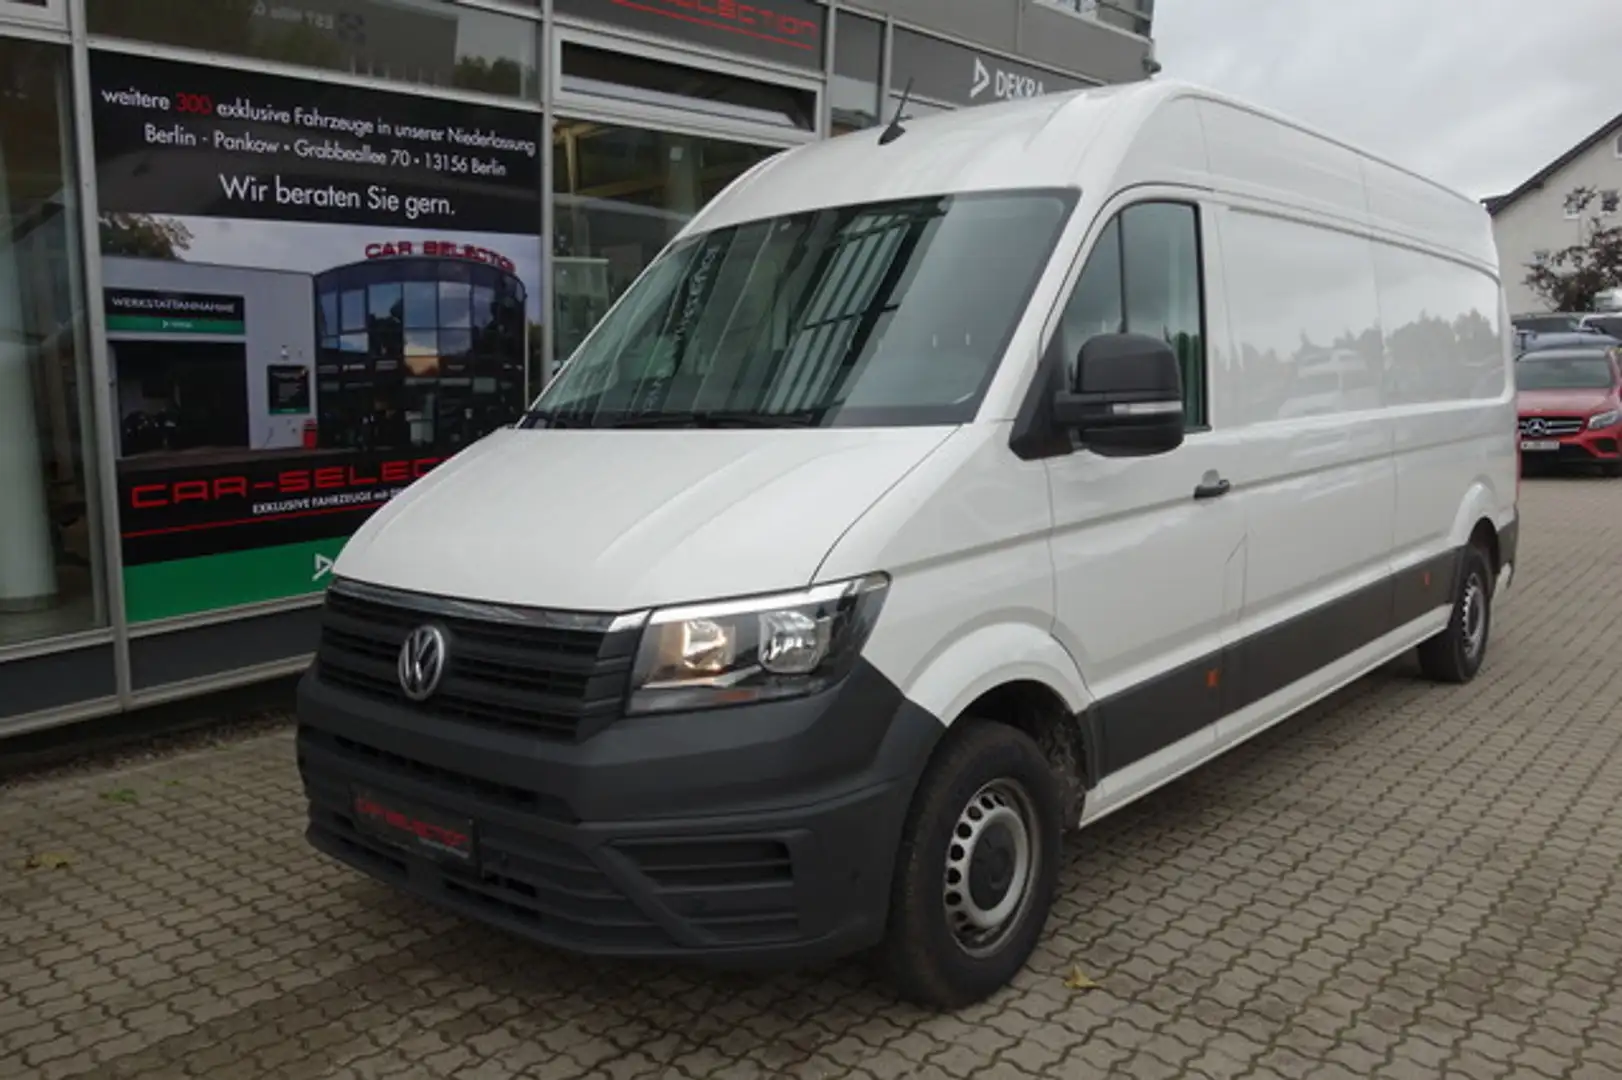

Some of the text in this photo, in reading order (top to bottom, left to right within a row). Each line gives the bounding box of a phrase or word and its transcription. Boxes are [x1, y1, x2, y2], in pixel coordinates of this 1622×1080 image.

[994, 69, 1046, 99] DEKRA
[101, 87, 536, 157] weitere 300 exklusive Fahrzeuge in unserer Niederlassung
[144, 122, 506, 176] Berlin Pankow Grabbeallee 70 13156 Berlin
[218, 173, 456, 220] Wir beraten Sie gern.
[252, 497, 310, 514] EXKLUSIVE
[312, 491, 372, 508] FAHRZEUGE
